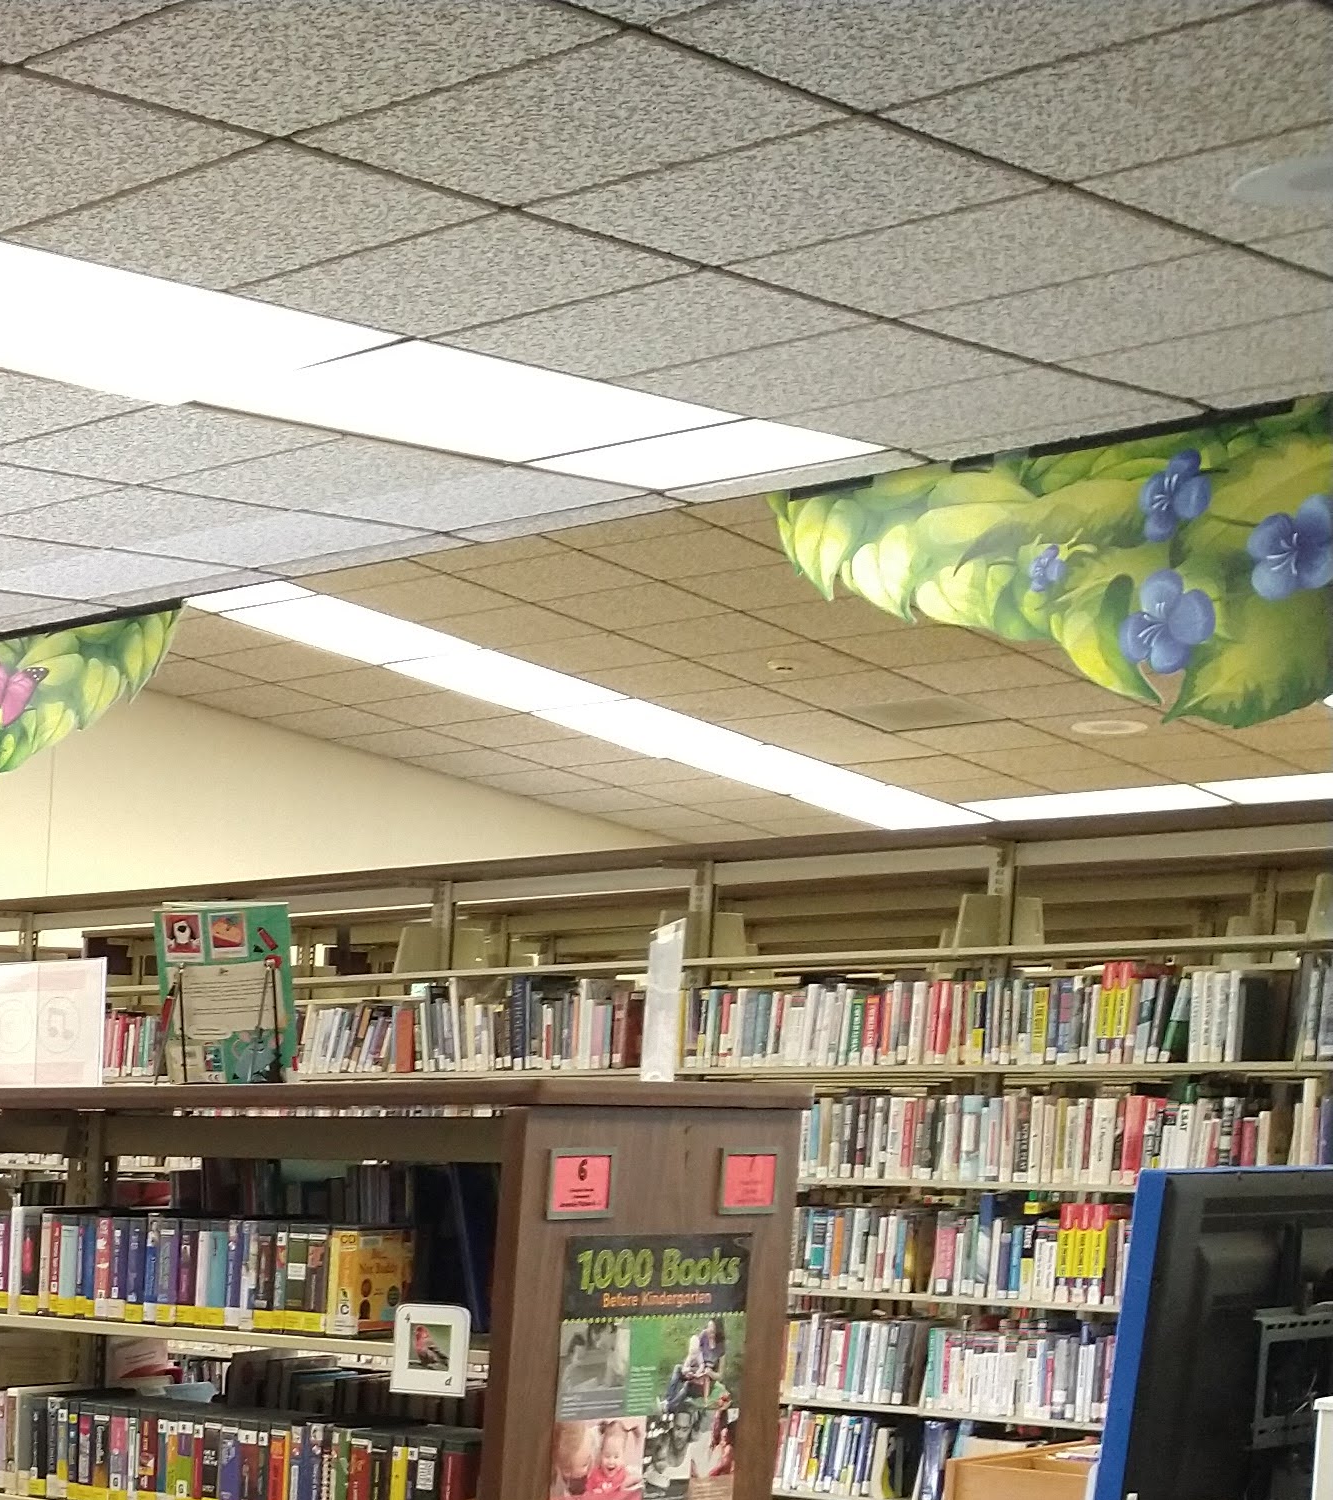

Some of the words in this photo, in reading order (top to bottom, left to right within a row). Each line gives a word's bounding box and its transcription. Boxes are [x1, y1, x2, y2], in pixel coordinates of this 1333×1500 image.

[577, 1159, 588, 1181] 6
[577, 1248, 655, 1295] 1,000
[660, 1246, 741, 1287] Books
[602, 1292, 638, 1308] Before
[641, 1290, 712, 1308] Kindergarten
